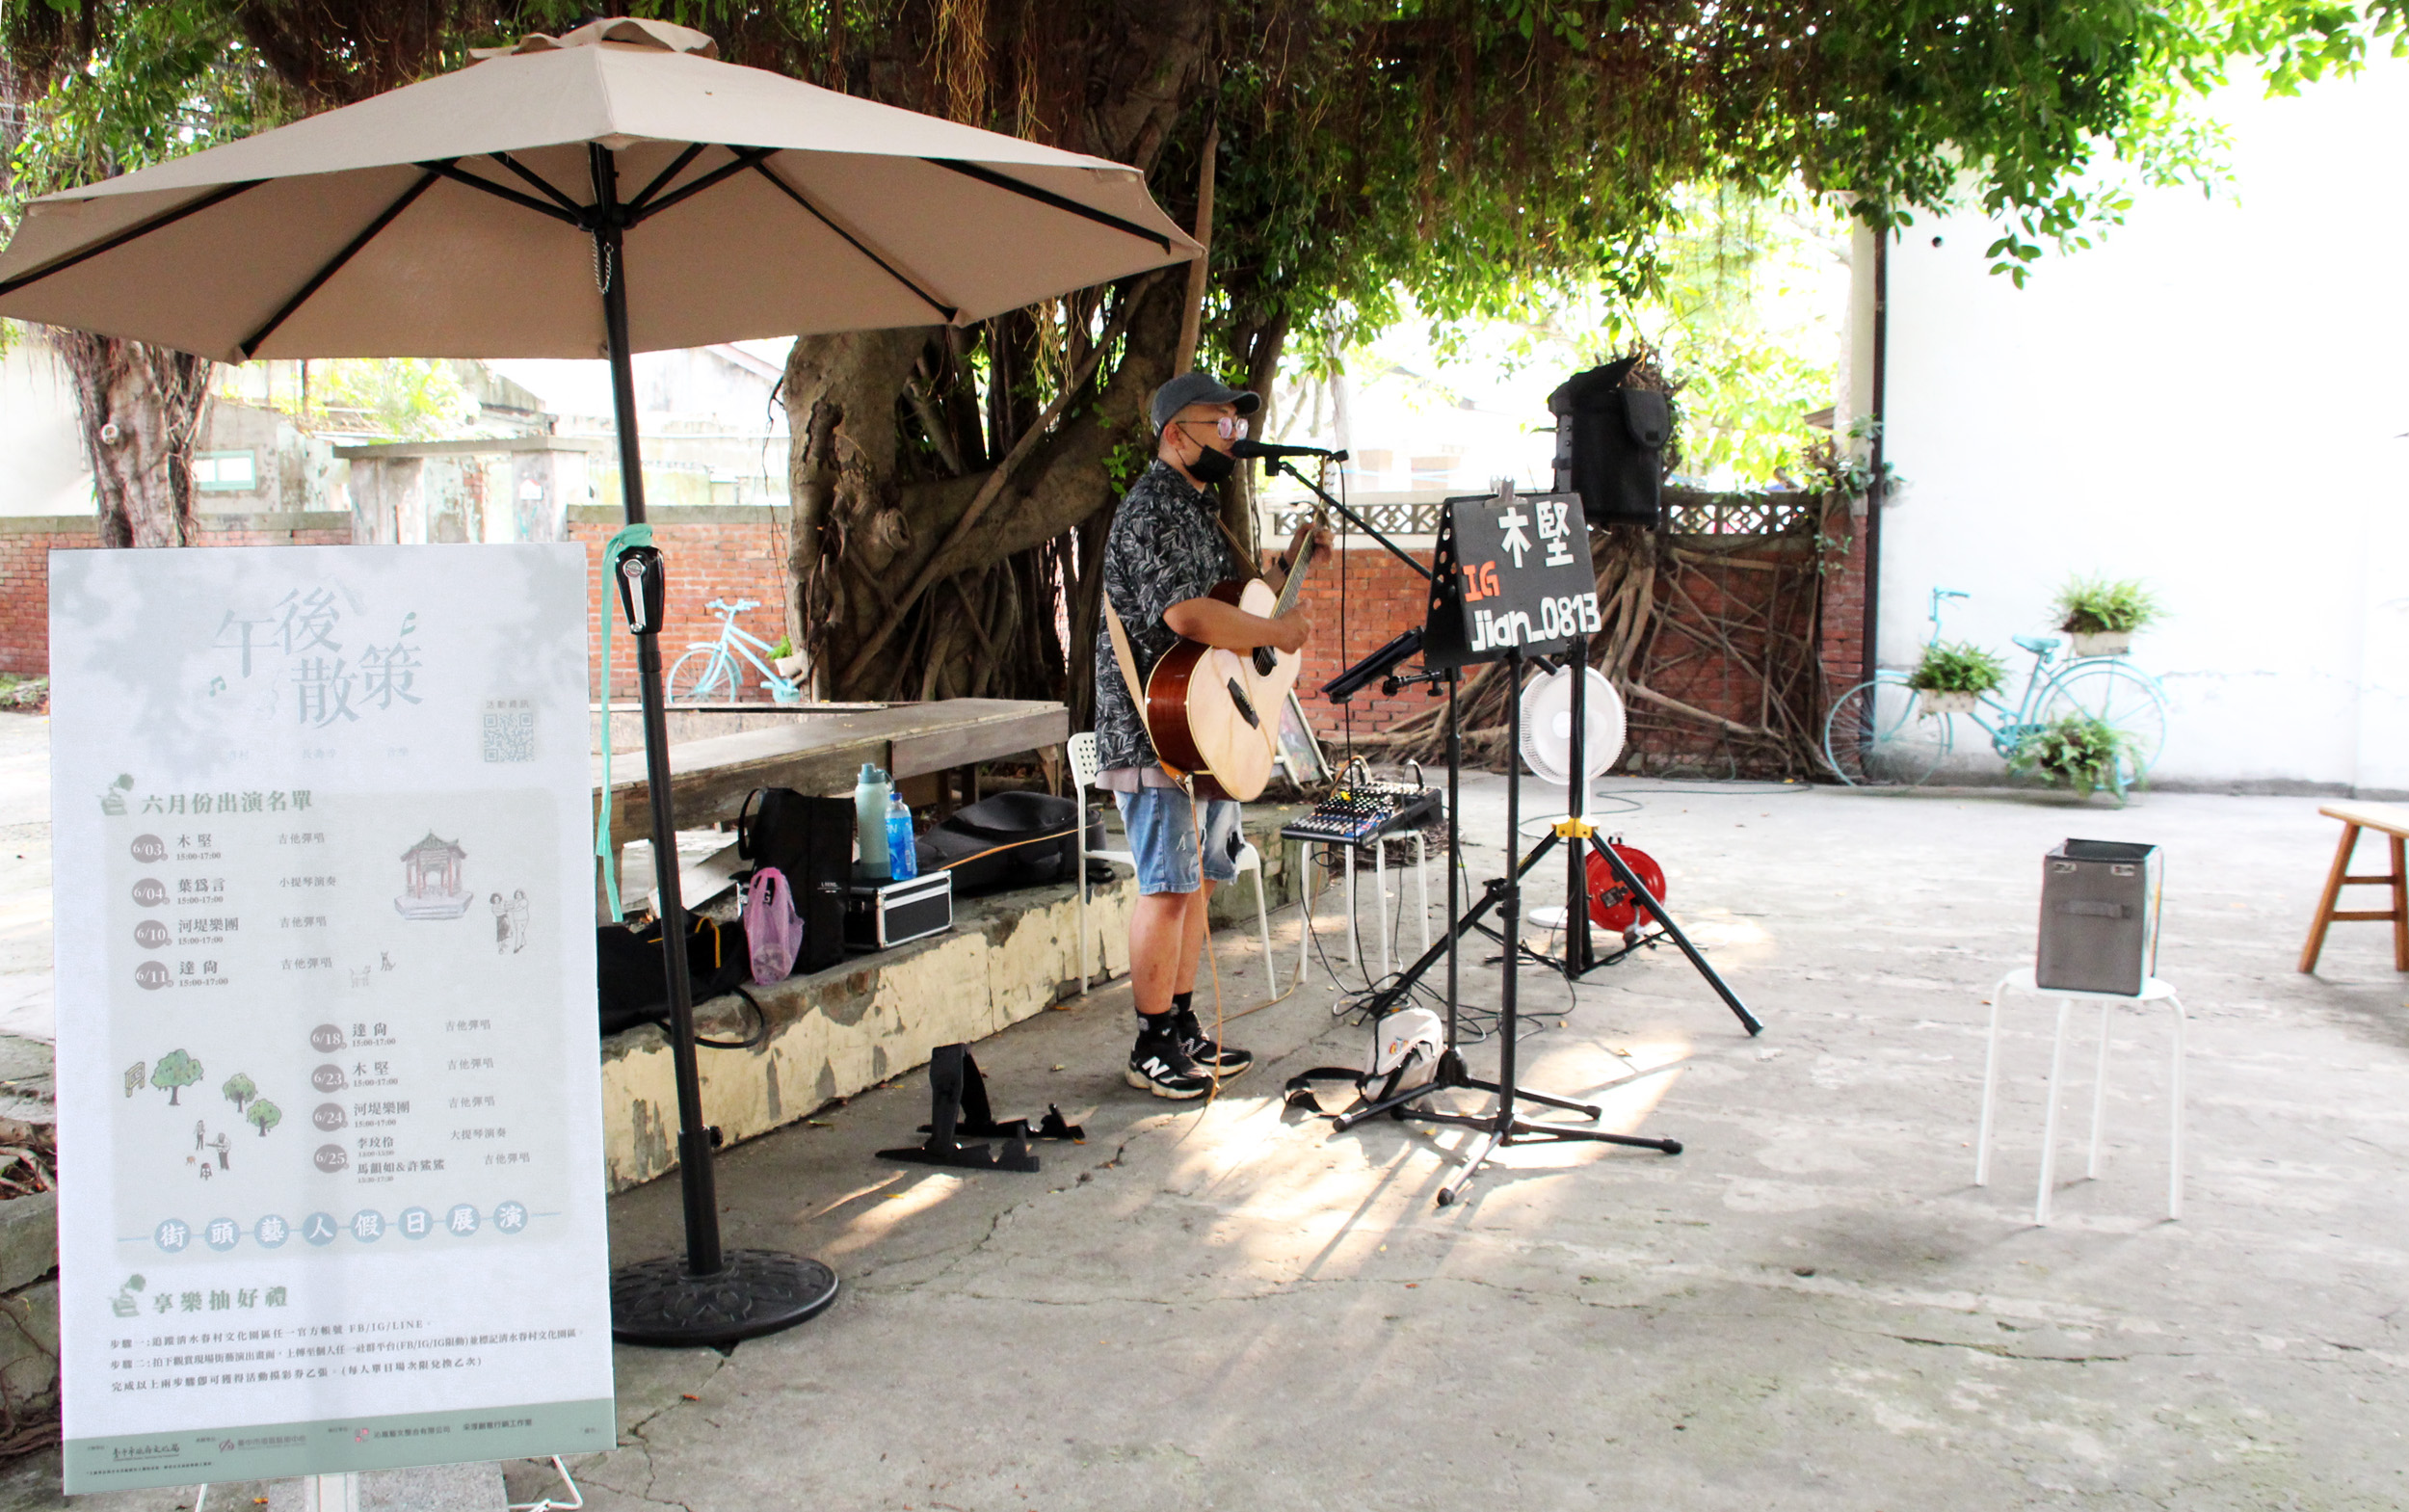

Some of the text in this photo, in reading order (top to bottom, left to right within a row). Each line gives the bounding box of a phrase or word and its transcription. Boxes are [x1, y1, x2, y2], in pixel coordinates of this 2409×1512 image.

[1497, 500, 1575, 569] 木堅
[1462, 560, 1500, 602] IG
[142, 789, 312, 814] 六月份出演名單
[278, 832, 326, 844] 吉他彈唱
[132, 844, 162, 855] 6/03
[279, 875, 336, 887] 小提琴演奏
[133, 886, 164, 899] 6/04
[177, 895, 224, 904] 15:00-17:00
[178, 917, 239, 932] 河堤樂團
[279, 915, 328, 927] 吉他彈唱
[137, 928, 167, 941] 6/10
[177, 936, 224, 944] 15:00-17:00
[281, 957, 333, 969] 吉他彈唱
[136, 970, 167, 982] 6/11
[179, 977, 228, 986] 15:00-17:00
[445, 1020, 491, 1031] 吉他彈唱
[312, 1033, 341, 1045] 6/18
[352, 1038, 396, 1047] 15:00-17:00
[447, 1058, 494, 1070] 吉他彈唱
[1142, 1056, 1171, 1078] N
[314, 1073, 343, 1084] 6/23
[354, 1077, 398, 1086] 15:00-17:00
[448, 1096, 495, 1107] 吉他彈唱
[353, 1101, 410, 1115] 河堤樂團
[314, 1111, 343, 1124] 6/24
[355, 1119, 397, 1127] 15:00-17:00
[450, 1127, 507, 1139] 大提琴演奏
[316, 1152, 346, 1164] 6/25
[485, 1153, 531, 1165] 吉他彈唱
[153, 1286, 287, 1313] 享樂抽好禮
